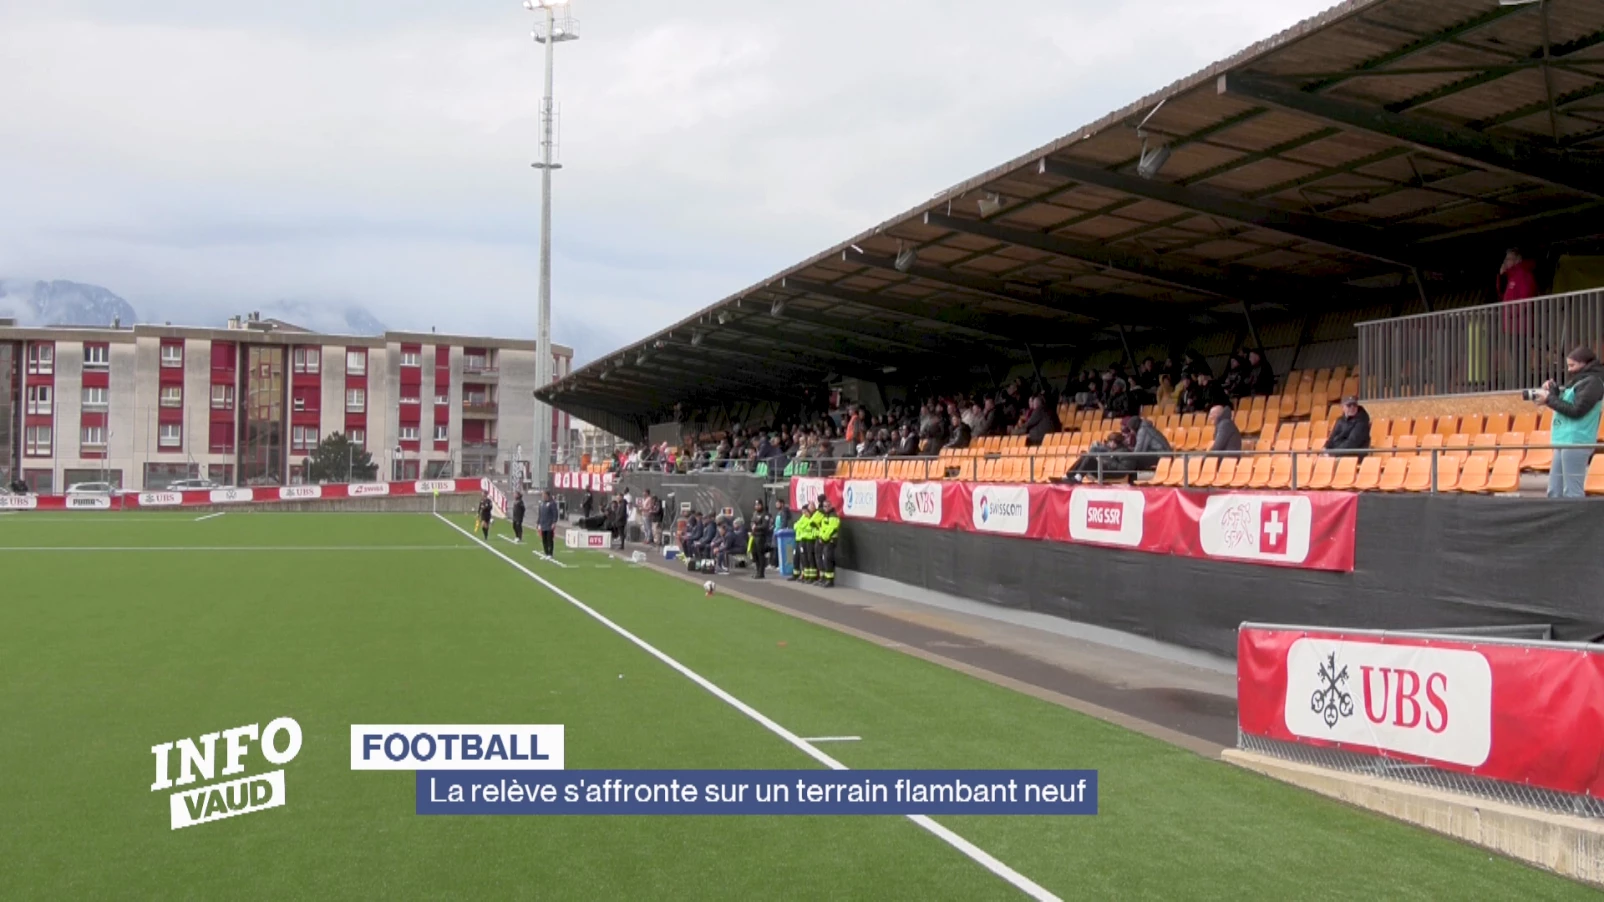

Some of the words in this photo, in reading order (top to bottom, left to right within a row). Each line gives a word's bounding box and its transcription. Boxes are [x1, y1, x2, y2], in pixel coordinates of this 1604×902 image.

[156, 493, 174, 502] UBS
[296, 488, 314, 496] UBS
[9, 498, 29, 506] UBS
[915, 491, 935, 514] UBS
[989, 499, 1023, 517] swisscom
[1088, 506, 1103, 524] SRG
[1104, 507, 1121, 525] SSR
[1360, 665, 1448, 734] UBS
